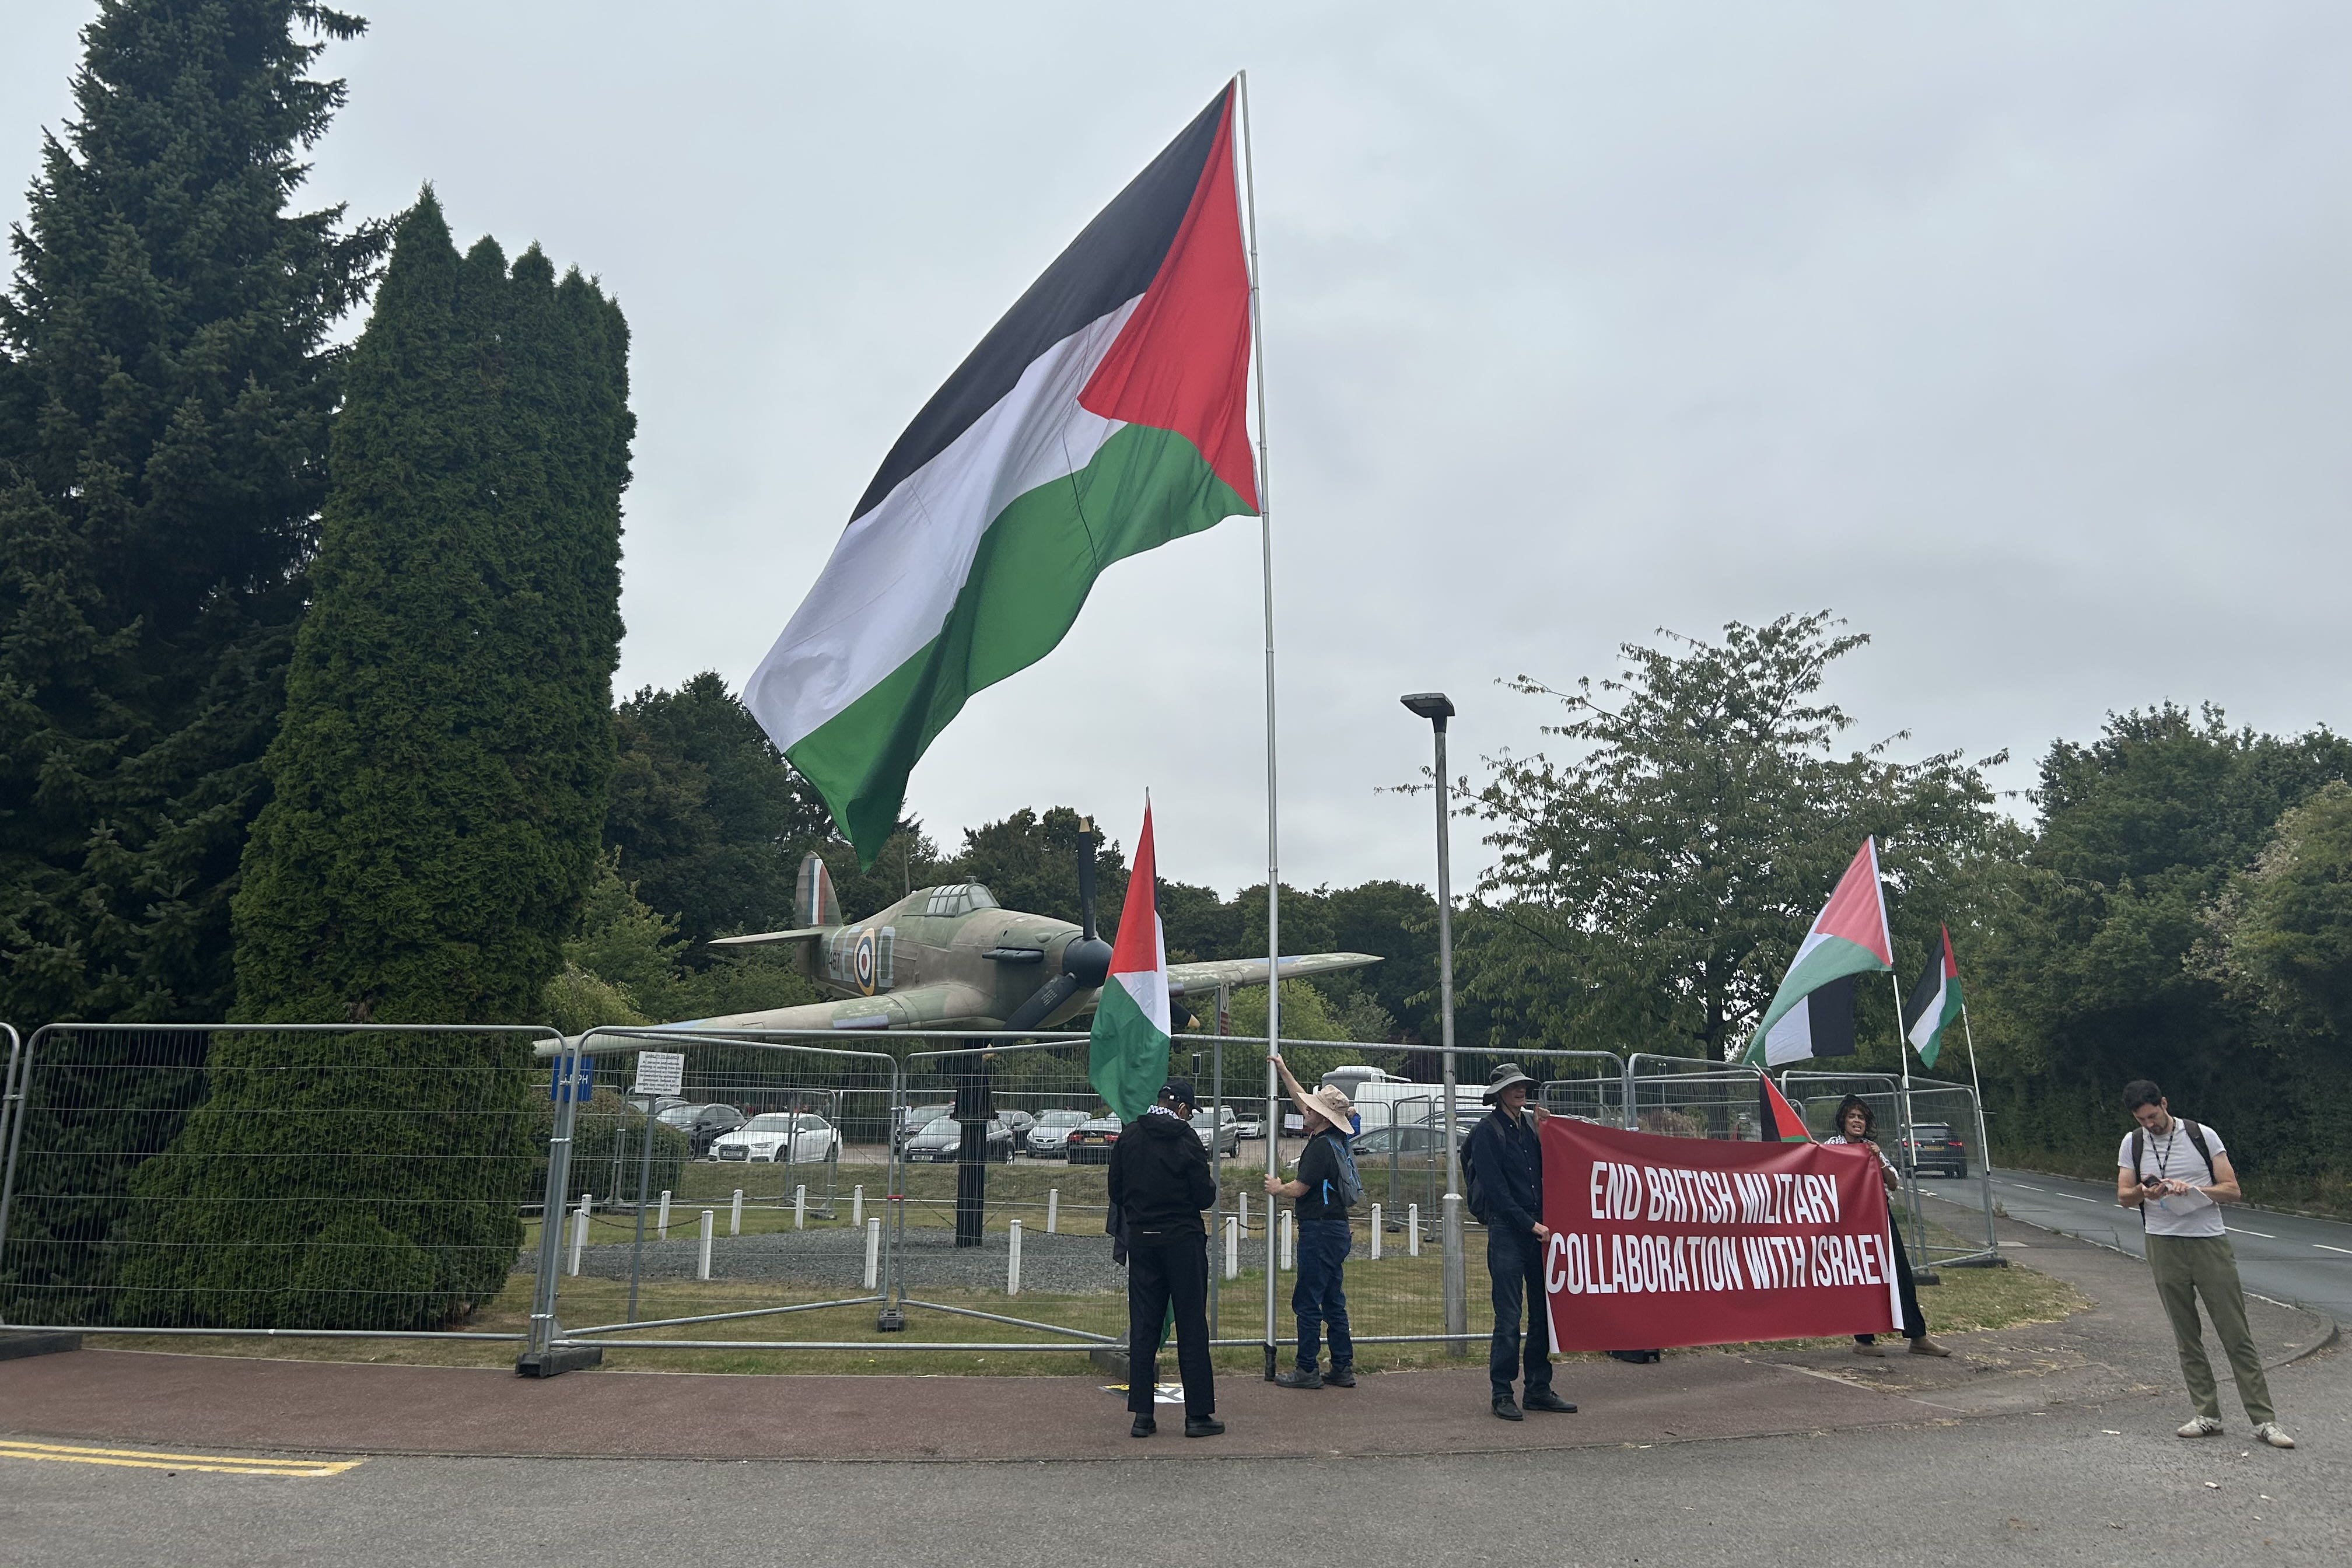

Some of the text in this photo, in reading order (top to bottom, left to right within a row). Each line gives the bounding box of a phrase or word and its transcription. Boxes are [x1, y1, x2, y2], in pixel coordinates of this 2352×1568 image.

[1590, 1160, 1840, 1224] END BRITISH MILITARY
[1545, 1232, 1890, 1294] COLLABORATION WITH ISRAEL
